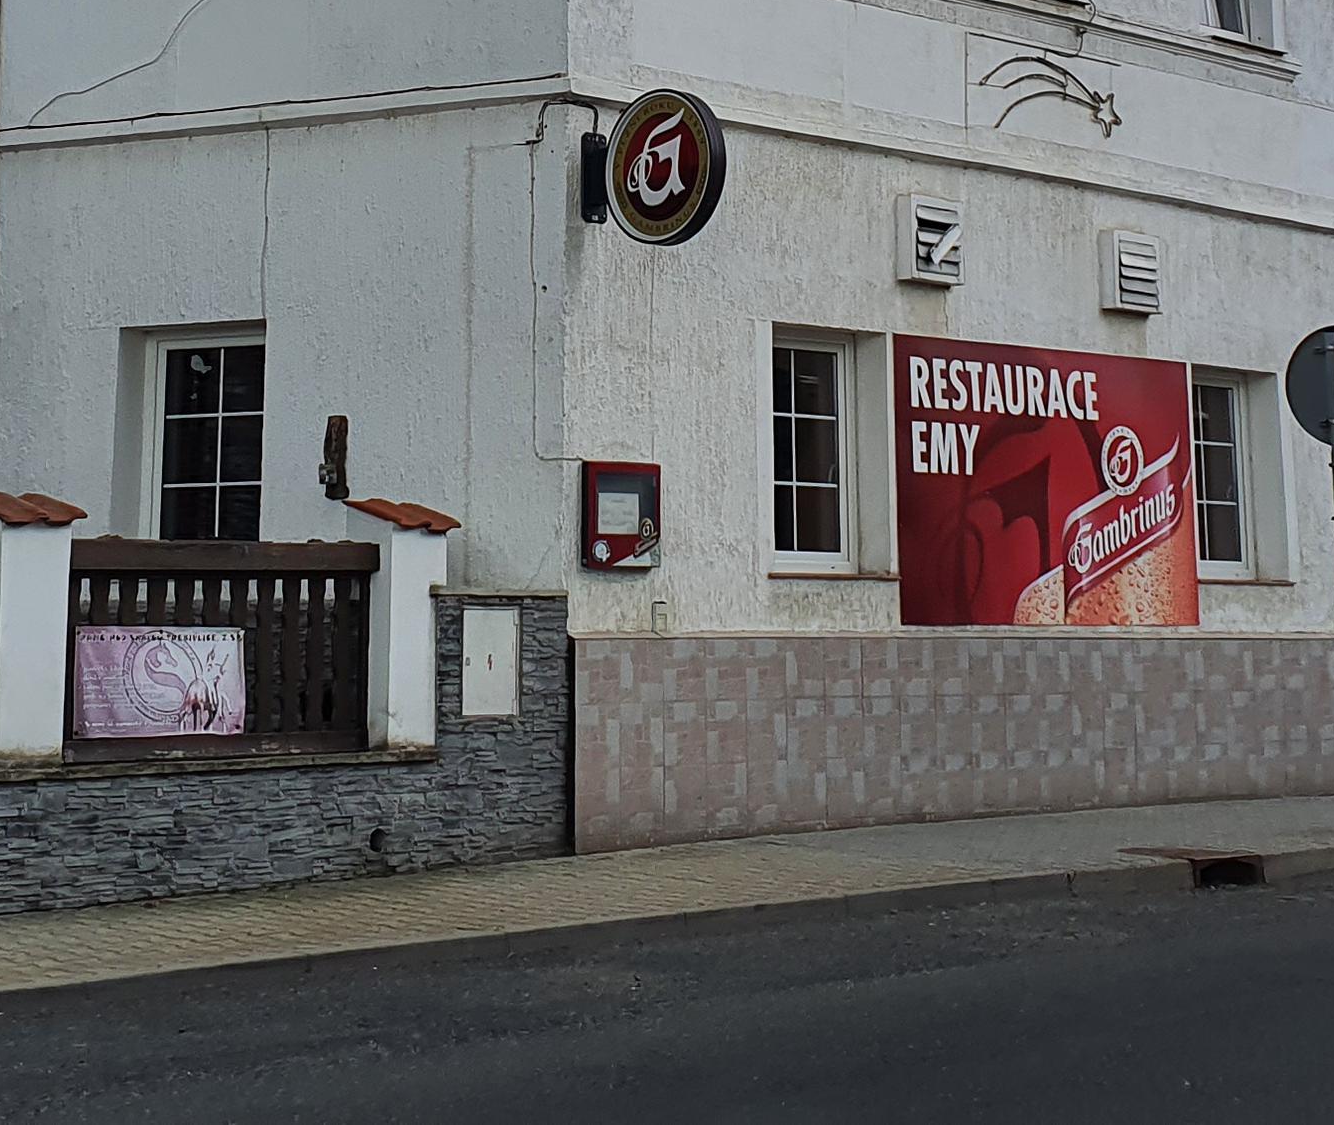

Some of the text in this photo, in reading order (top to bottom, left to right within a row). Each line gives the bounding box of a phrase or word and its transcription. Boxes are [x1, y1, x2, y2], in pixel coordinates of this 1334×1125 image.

[909, 356, 1100, 421] RESTAURACE
[911, 421, 981, 476] EMY
[1067, 483, 1177, 575] Gambrinus
